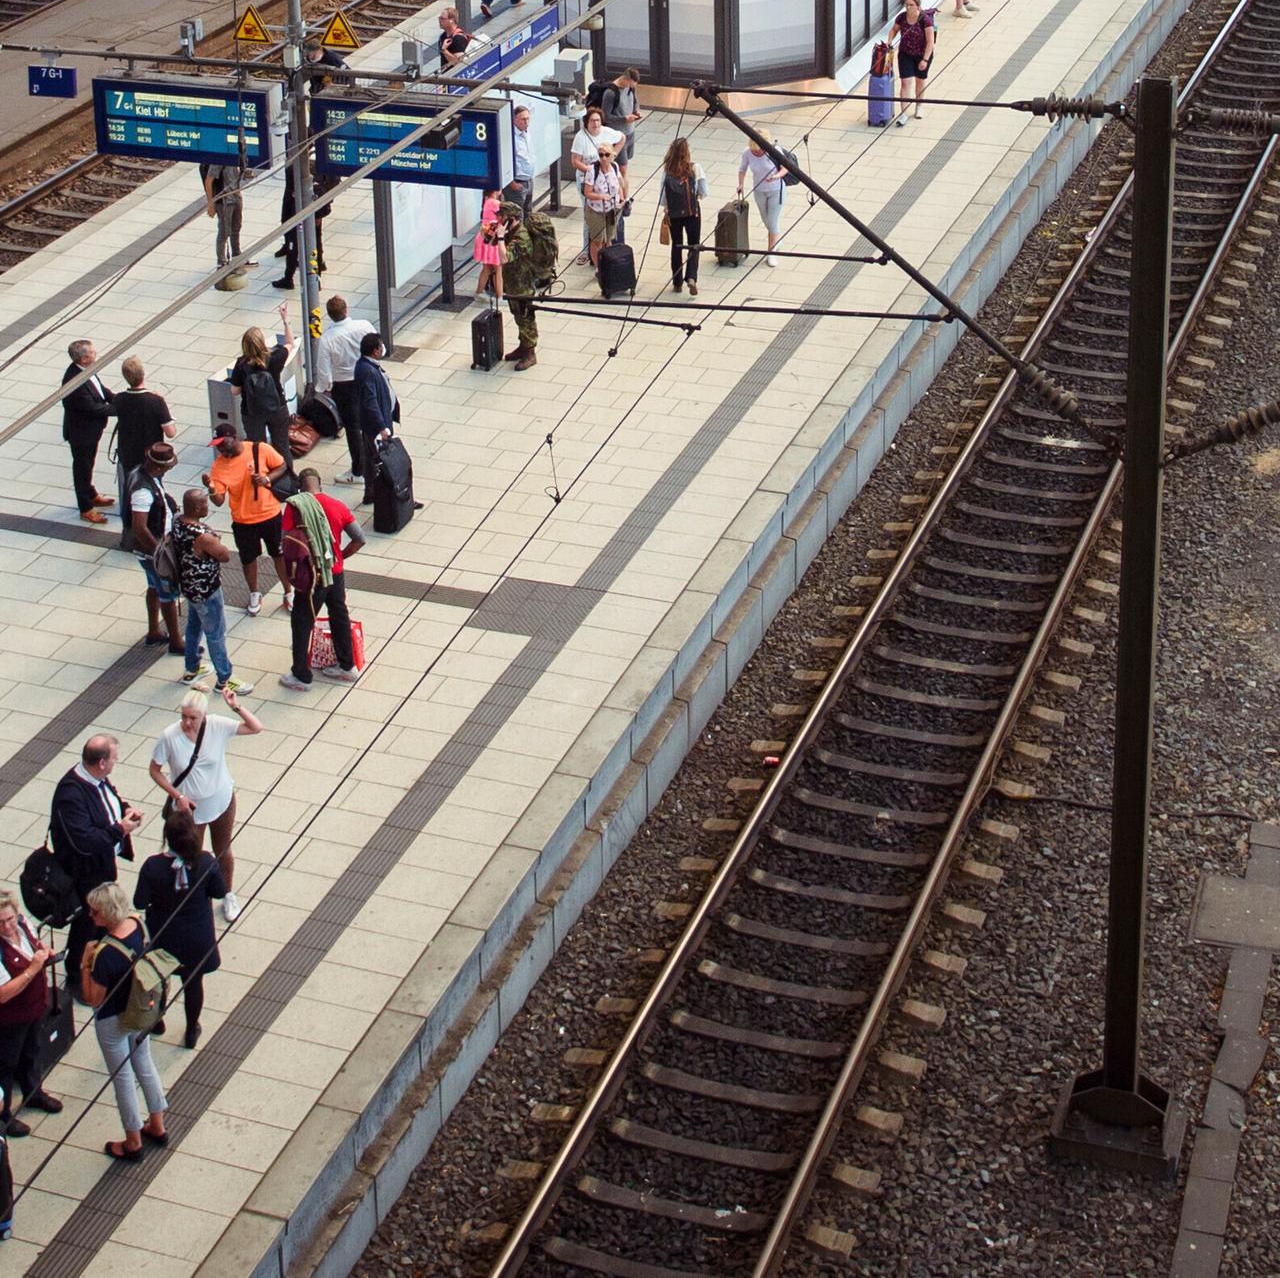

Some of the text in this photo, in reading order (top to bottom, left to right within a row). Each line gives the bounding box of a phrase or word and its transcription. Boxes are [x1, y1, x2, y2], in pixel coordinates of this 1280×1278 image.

[41, 68, 47, 78] 7
[113, 91, 125, 110] 7
[135, 105, 169, 118] Kiel Hbf
[326, 110, 345, 119] 14:33
[109, 124, 125, 132] 14:34
[475, 122, 487, 141] 8
[109, 133, 125, 142] 15:22
[167, 130, 201, 140] Lübeck Hbf
[167, 139, 191, 148] Kiel Hbf
[328, 144, 345, 153] 14:44
[328, 153, 346, 162] 15:01
[427, 153, 438, 162] Hbf
[391, 159, 432, 170] München Hbf
